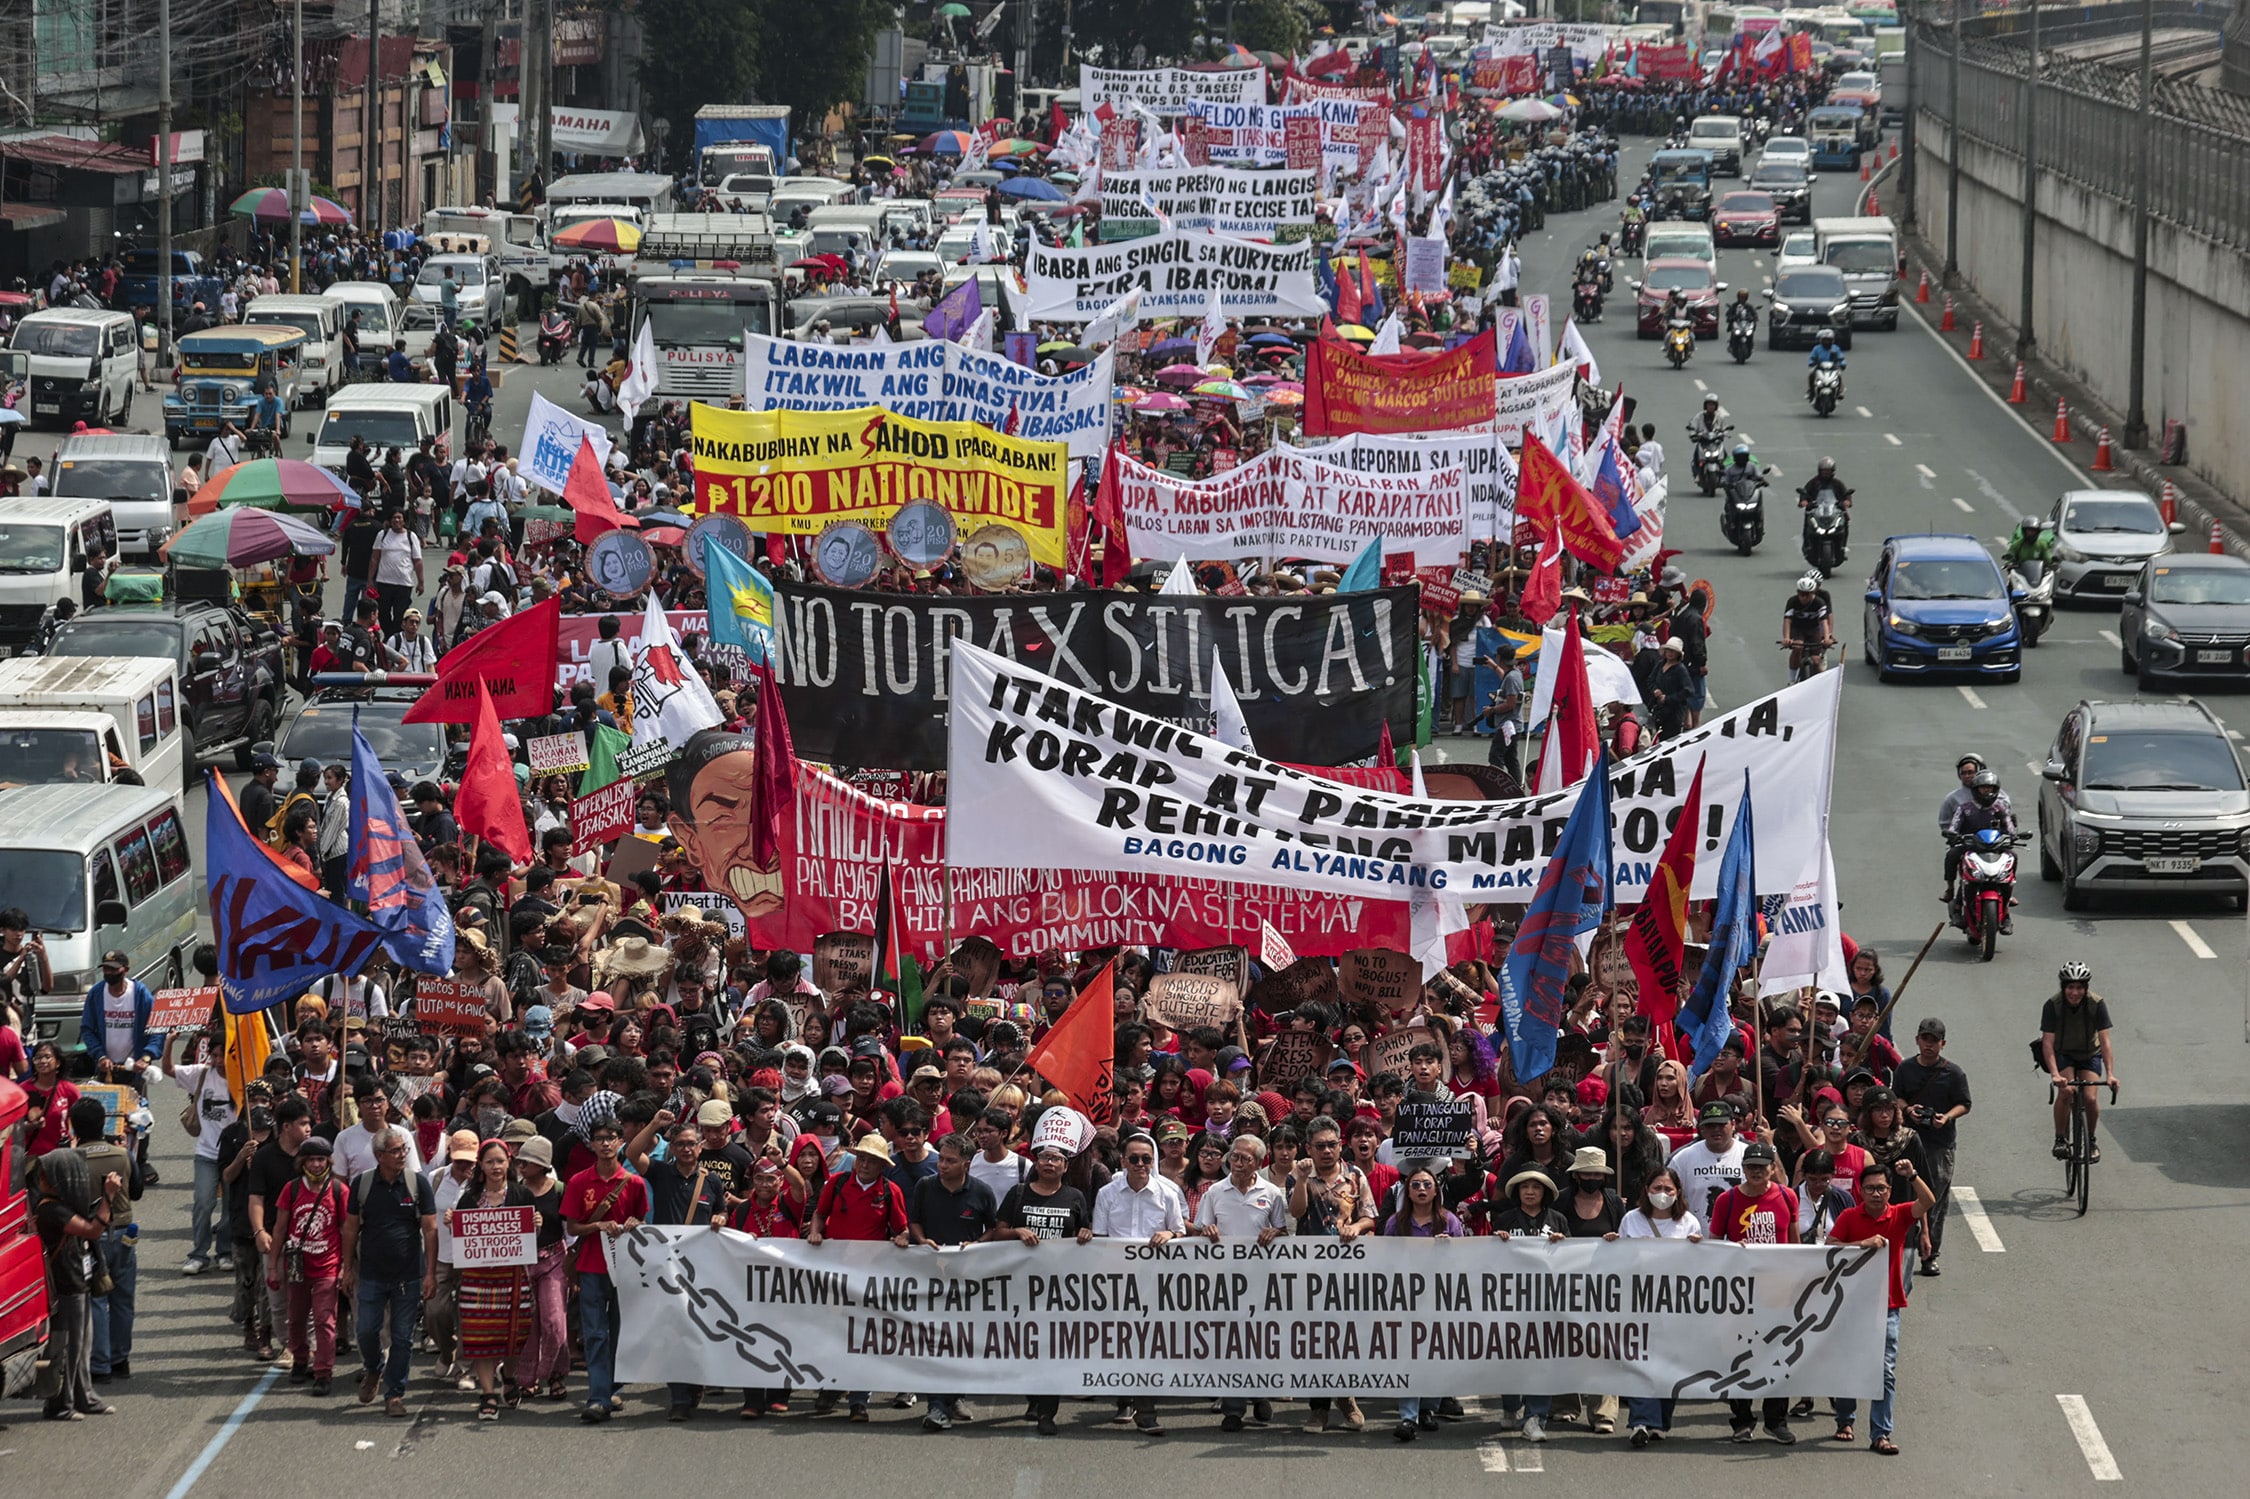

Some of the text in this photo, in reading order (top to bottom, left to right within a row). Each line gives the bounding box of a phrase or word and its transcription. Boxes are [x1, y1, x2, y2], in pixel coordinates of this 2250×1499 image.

[1091, 70, 1162, 82] DISMANTLE
[1103, 83, 1129, 92] AND
[1136, 84, 1161, 94] ALL
[1196, 83, 1244, 94] BASES!
[1187, 101, 1265, 128] SWELDO NG
[1148, 172, 1316, 196] ANG PRESYO NG LANGIS
[1176, 200, 1196, 214] ANG
[1218, 202, 1231, 214] AT
[1234, 200, 1288, 218] EXCISE
[1033, 238, 1217, 280] IBABA ANG SINGIL SA
[667, 352, 736, 364] PULISYA
[767, 342, 944, 370] LABANAN ANG
[1456, 356, 1473, 378] AT
[764, 370, 1068, 412] ITAKWIL ANG DINASTIYA!
[1501, 389, 1513, 398] AT
[1021, 404, 1105, 438] IBAGSAK!
[694, 432, 1058, 472] NAKABUBUHAY NA IPAGLABAN!
[1351, 447, 1450, 473] REPORMA SA
[1316, 464, 1462, 492] IPAGLABAN ANG
[828, 464, 1043, 526] NATIONWIDE
[1174, 479, 1462, 518] KABUHAYAN, AT KARAPATAN!
[790, 518, 812, 530] KMU
[926, 525, 945, 538] 20
[1168, 514, 1210, 535] LABAN
[1216, 516, 1235, 532] SA
[1348, 511, 1464, 538] PANDARAMBONG!
[926, 536, 948, 545] PISO
[1290, 532, 1358, 553] PARTYLIST
[625, 550, 644, 565] 20
[852, 551, 872, 566] 20
[628, 561, 650, 574] PISO
[850, 562, 872, 574] PISO
[1457, 568, 1482, 586] LOKAL
[1427, 583, 1457, 600] DUTERTE
[773, 592, 838, 689] NO
[850, 601, 917, 696] TO
[928, 601, 1103, 700] PAX
[1104, 598, 1396, 700] SILICA!
[988, 672, 1204, 760] ITAKWIL
[531, 735, 564, 751] STATE
[614, 738, 663, 764] MILITAR SA
[532, 745, 579, 760] NAKAWAN
[539, 753, 582, 768] ADDRESS
[621, 744, 670, 770] KANAYUNAN
[985, 720, 1278, 818] KORAP AT
[572, 779, 634, 821] IMPERYALISMO
[578, 802, 634, 842] IBAGSAK!
[1124, 836, 1448, 890] BAGONG ALYANSANG
[2148, 858, 2194, 872] NKT 9335
[902, 866, 944, 906] ANG
[666, 894, 738, 910] What the
[969, 884, 1364, 935] ANG BULOK NA SISTEMA!
[1010, 920, 1166, 957] COMMUNITY
[838, 948, 870, 960] ITAAS!
[1184, 950, 1239, 967] EDUCATION
[1354, 954, 1388, 970] NO TO
[828, 958, 859, 970] PRESYO
[1214, 964, 1236, 976] FOR
[837, 969, 869, 982] IBABA!
[202, 986, 218, 995] TAO
[416, 980, 455, 996] MARCOS
[1164, 978, 1220, 994] MARCOS
[1354, 980, 1403, 998] NPU BILL
[168, 997, 195, 1008] WAG SA
[1164, 990, 1211, 1002] SINGILIN
[416, 998, 486, 1018] TUTA NG KANO
[148, 1006, 211, 1028] IMPERYALISTA
[1375, 1032, 1415, 1057] SAHOD
[1272, 1047, 1314, 1064] PRESS
[1398, 1101, 1472, 1116] VAT TANGGALIN,
[1042, 1116, 1072, 1129] STOP
[1414, 1116, 1454, 1130] KORAP
[1048, 1126, 1066, 1136] THE
[1398, 1130, 1469, 1146] PANAGUTIN!
[1034, 1131, 1078, 1149] KILLINGS!
[1403, 1146, 1454, 1158] GABRIELA
[1694, 1164, 1742, 1178] nothing
[461, 1208, 522, 1224] DISMANTLE
[1026, 1215, 1065, 1228] FREE ALL
[462, 1220, 522, 1235] US BASES!
[1746, 1224, 1776, 1237] ITAAS!
[464, 1235, 522, 1249] US TROOPS
[464, 1246, 524, 1260] OUT NOW!
[1124, 1244, 1366, 1261] SONA NG BAYAN 2026
[746, 1264, 1755, 1318] ITAKWIL ANG PAPET, PASISTA, KORAP, AT PAHIRAP NA REHIMENG MARCOS!
[846, 1314, 1650, 1362] LABANAN ANG IMPERYALISTANG GERA AT PANDARAMBONG!
[1082, 1372, 1410, 1390] BAGONG ALYANSANG MAKABAYAN
